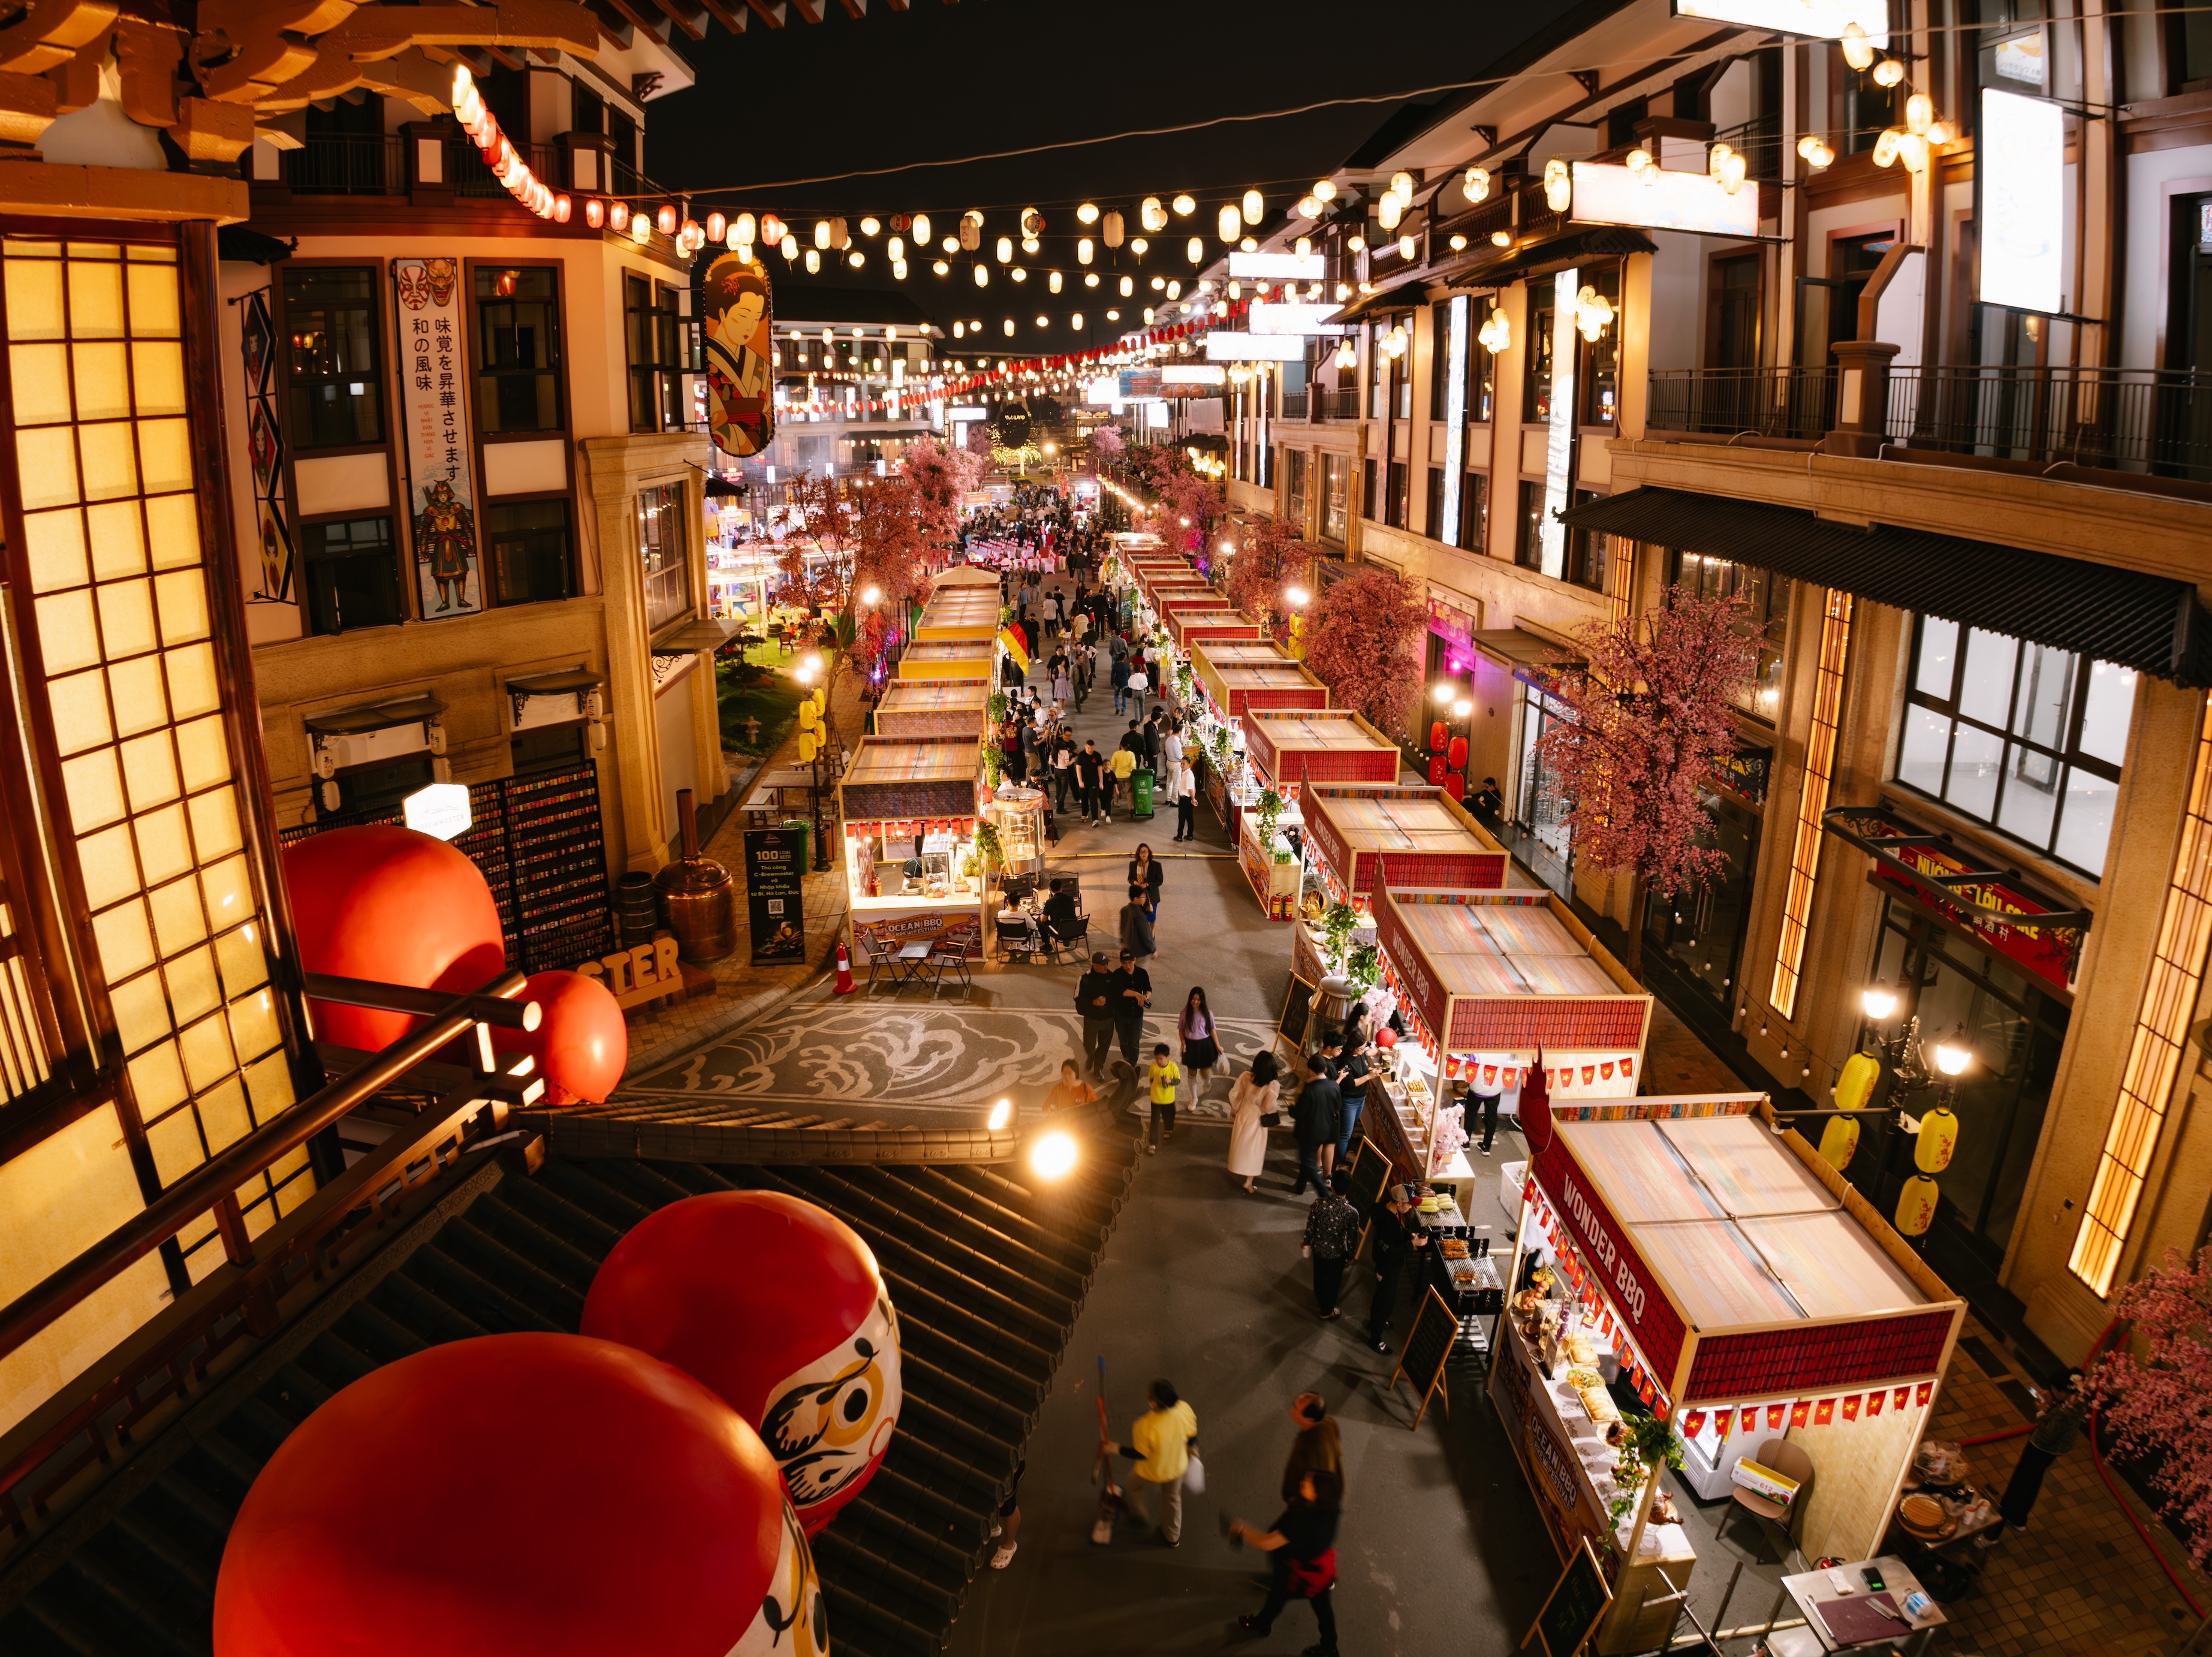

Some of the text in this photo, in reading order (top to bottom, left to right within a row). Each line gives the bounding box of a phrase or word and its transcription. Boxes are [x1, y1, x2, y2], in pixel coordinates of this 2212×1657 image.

[412, 318, 432, 391] 和の風味
[435, 317, 460, 481] 味覚を昇華させます
[756, 850, 779, 860] 100
[1315, 814, 1340, 866] WONDER BBQ
[888, 921, 921, 932] OCEAN
[923, 918, 943, 927] BBQ
[1975, 884, 2002, 911] LẨU
[1393, 927, 1429, 1007] WONDER BBQ
[1563, 1172, 1646, 1325] WONDER BBQ
[1532, 1415, 1559, 1469] OCEAN
[1559, 1463, 1577, 1507] BBQ
[1533, 1440, 1548, 1467] BREW
[1547, 1466, 1571, 1511] FESTIVAL
[1759, 1483, 1773, 1493] 612
